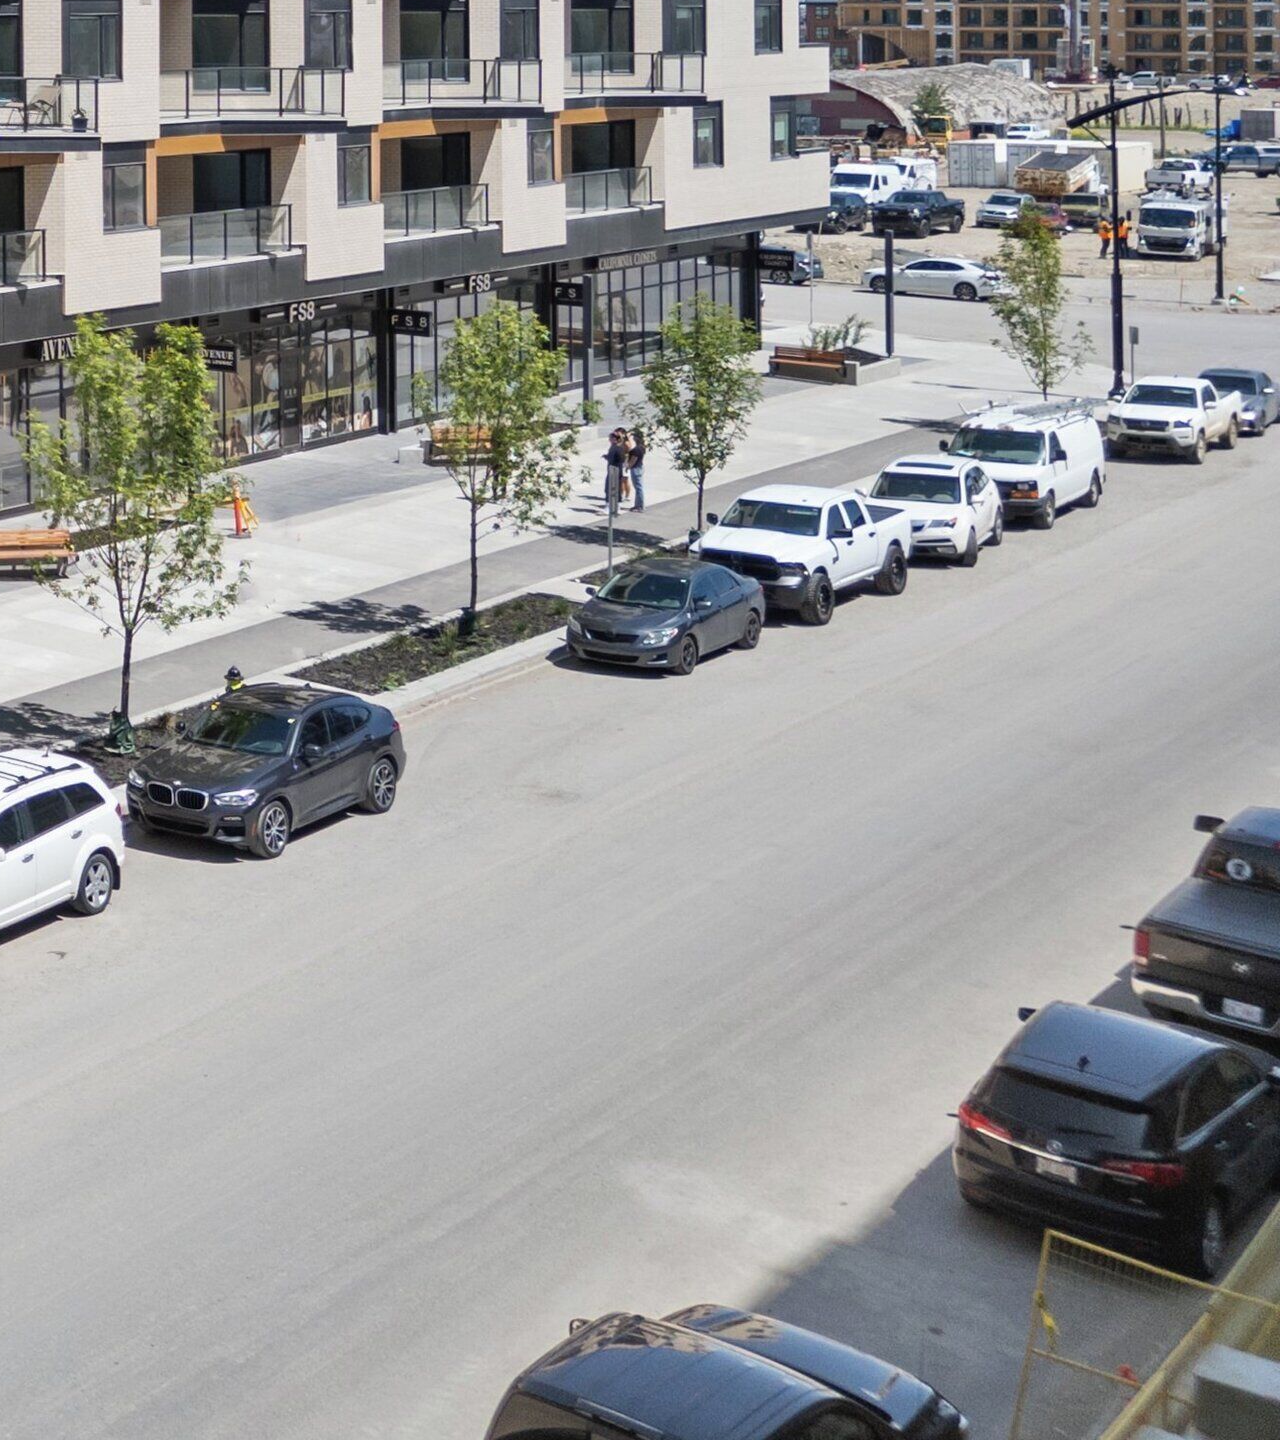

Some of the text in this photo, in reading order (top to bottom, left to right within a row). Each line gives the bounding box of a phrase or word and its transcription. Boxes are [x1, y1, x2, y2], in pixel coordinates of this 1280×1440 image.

[469, 274, 490, 294] FS8
[555, 287, 576, 298] FS
[290, 301, 315, 323] FS8
[41, 337, 77, 362] AVEN
